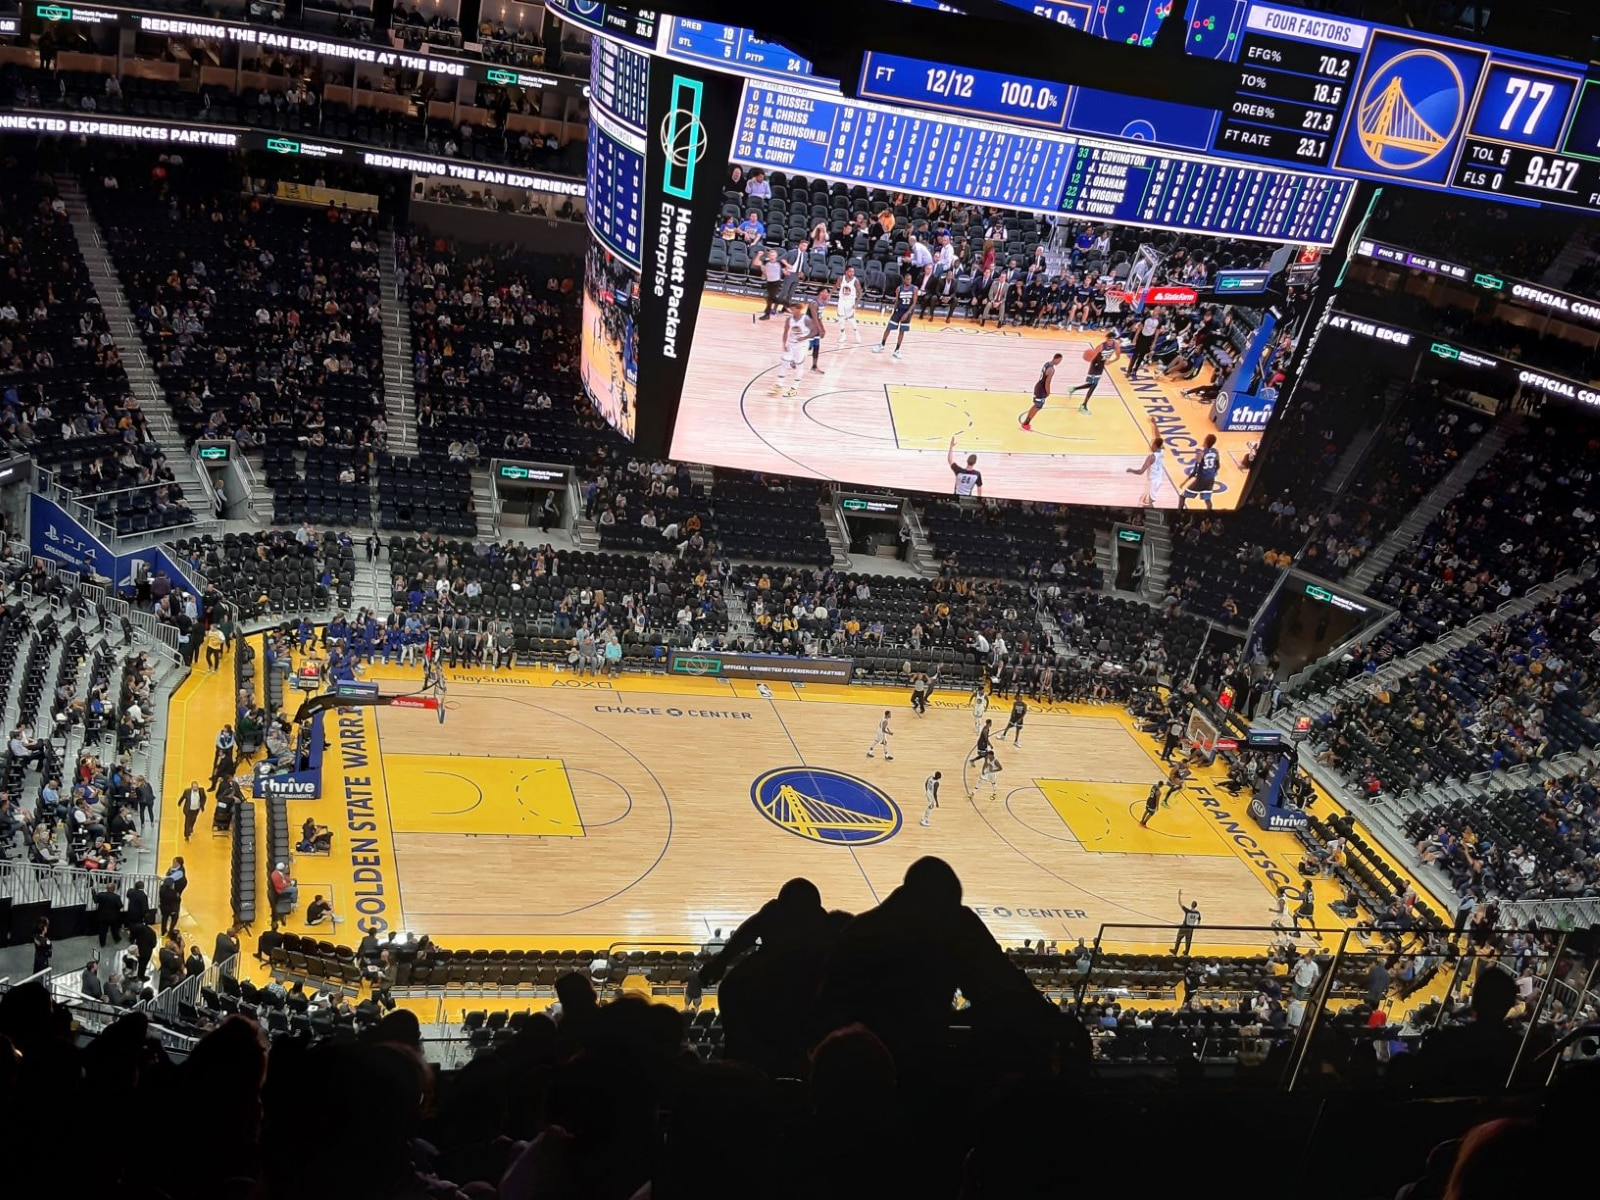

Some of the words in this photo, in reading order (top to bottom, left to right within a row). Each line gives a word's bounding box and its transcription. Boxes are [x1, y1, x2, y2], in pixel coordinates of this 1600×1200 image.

[681, 19, 702, 31] DREB
[723, 27, 734, 40] 19
[1264, 12, 1297, 32] FOUR
[1298, 19, 1351, 42] FACTORS
[141, 16, 225, 38] REDEFINING
[228, 27, 256, 42] THE
[258, 32, 288, 48] FAN
[290, 37, 375, 63] EXPERIENCE
[377, 52, 398, 66] AT
[400, 55, 427, 71] THE
[429, 60, 464, 76] EDGE
[678, 37, 692, 47] STL
[724, 45, 731, 58] 5
[787, 58, 801, 72] 24
[1248, 46, 1282, 62] EFG%
[1318, 55, 1350, 77] 70.2
[875, 66, 895, 82] FT
[926, 68, 975, 98] 12/12
[1001, 80, 1058, 110] 100.0%
[1241, 73, 1267, 88] TO%
[1313, 83, 1342, 104] 18.5
[753, 90, 760, 101] 0
[765, 92, 775, 105] D.
[776, 94, 815, 112] RUSSELL
[1500, 77, 1554, 135] 77
[746, 103, 759, 116] 32
[763, 106, 774, 119] M.
[775, 108, 809, 125] CHRISS
[1232, 102, 1275, 119] OREB%
[1302, 110, 1334, 131] 27.3
[0, 115, 67, 132] NNECTED
[69, 120, 168, 140] EXPERIENCES
[170, 129, 237, 146] PARTNER
[741, 130, 754, 143] 23
[757, 133, 766, 146] D.
[767, 135, 798, 151] GREEN
[744, 116, 757, 129] 22
[760, 119, 769, 132] G.
[770, 121, 816, 141] ROBINSON
[861, 138, 868, 150] 4
[1224, 129, 1240, 142] FT
[1241, 132, 1272, 146] RATE
[738, 144, 751, 157] 30
[754, 147, 763, 160] S.
[764, 149, 795, 165] CURRY
[829, 161, 843, 173] 20
[852, 164, 865, 177] 27
[1077, 147, 1090, 159] 33
[1092, 149, 1100, 160] R.
[1101, 150, 1147, 167] COVINGTON
[1296, 138, 1326, 158] 23.1
[1472, 146, 1494, 161] TOL
[1501, 148, 1511, 165] 5
[364, 153, 446, 175] REDEFINING
[448, 164, 476, 179] THE
[477, 169, 505, 184] FAN
[507, 174, 587, 197] EXPERIENCE
[1071, 173, 1081, 184] 12
[1084, 174, 1092, 186] T.
[1092, 176, 1127, 191] GRAHAM
[1151, 184, 1162, 196] 12
[1076, 160, 1083, 171] 0
[1087, 163, 1096, 173] J.
[1097, 163, 1128, 177] TEAGUE
[1175, 174, 1185, 185] 11
[1463, 171, 1486, 185] FLS
[1491, 173, 1502, 190] 0
[1524, 155, 1579, 191] 9:57
[1061, 198, 1074, 209] 32
[1076, 200, 1084, 211] K.
[1085, 201, 1116, 216] TOWNS
[1065, 185, 1078, 197] 22
[1079, 187, 1088, 199] A.
[1089, 188, 1125, 204] WIGGINS
[653, 202, 675, 298] Enterprise
[670, 207, 692, 283] Hewlett
[1512, 284, 1569, 310] OFFICIAL
[663, 285, 685, 359] Packard
[1329, 316, 1348, 328] AT
[1350, 320, 1376, 336] THE
[1376, 327, 1410, 345] EDGE
[1519, 371, 1575, 397] OFFICIAL
[1202, 458, 1215, 470] 33
[62, 534, 98, 560] PS4
[453, 674, 531, 685] PlayStation
[594, 705, 662, 716] CHASE
[688, 709, 752, 720] CENTER
[261, 777, 315, 793] thrive
[344, 776, 377, 831] STATE
[1270, 814, 1308, 828] thrive
[351, 838, 388, 934] GOLDEN
[1016, 907, 1089, 920] CENTER
